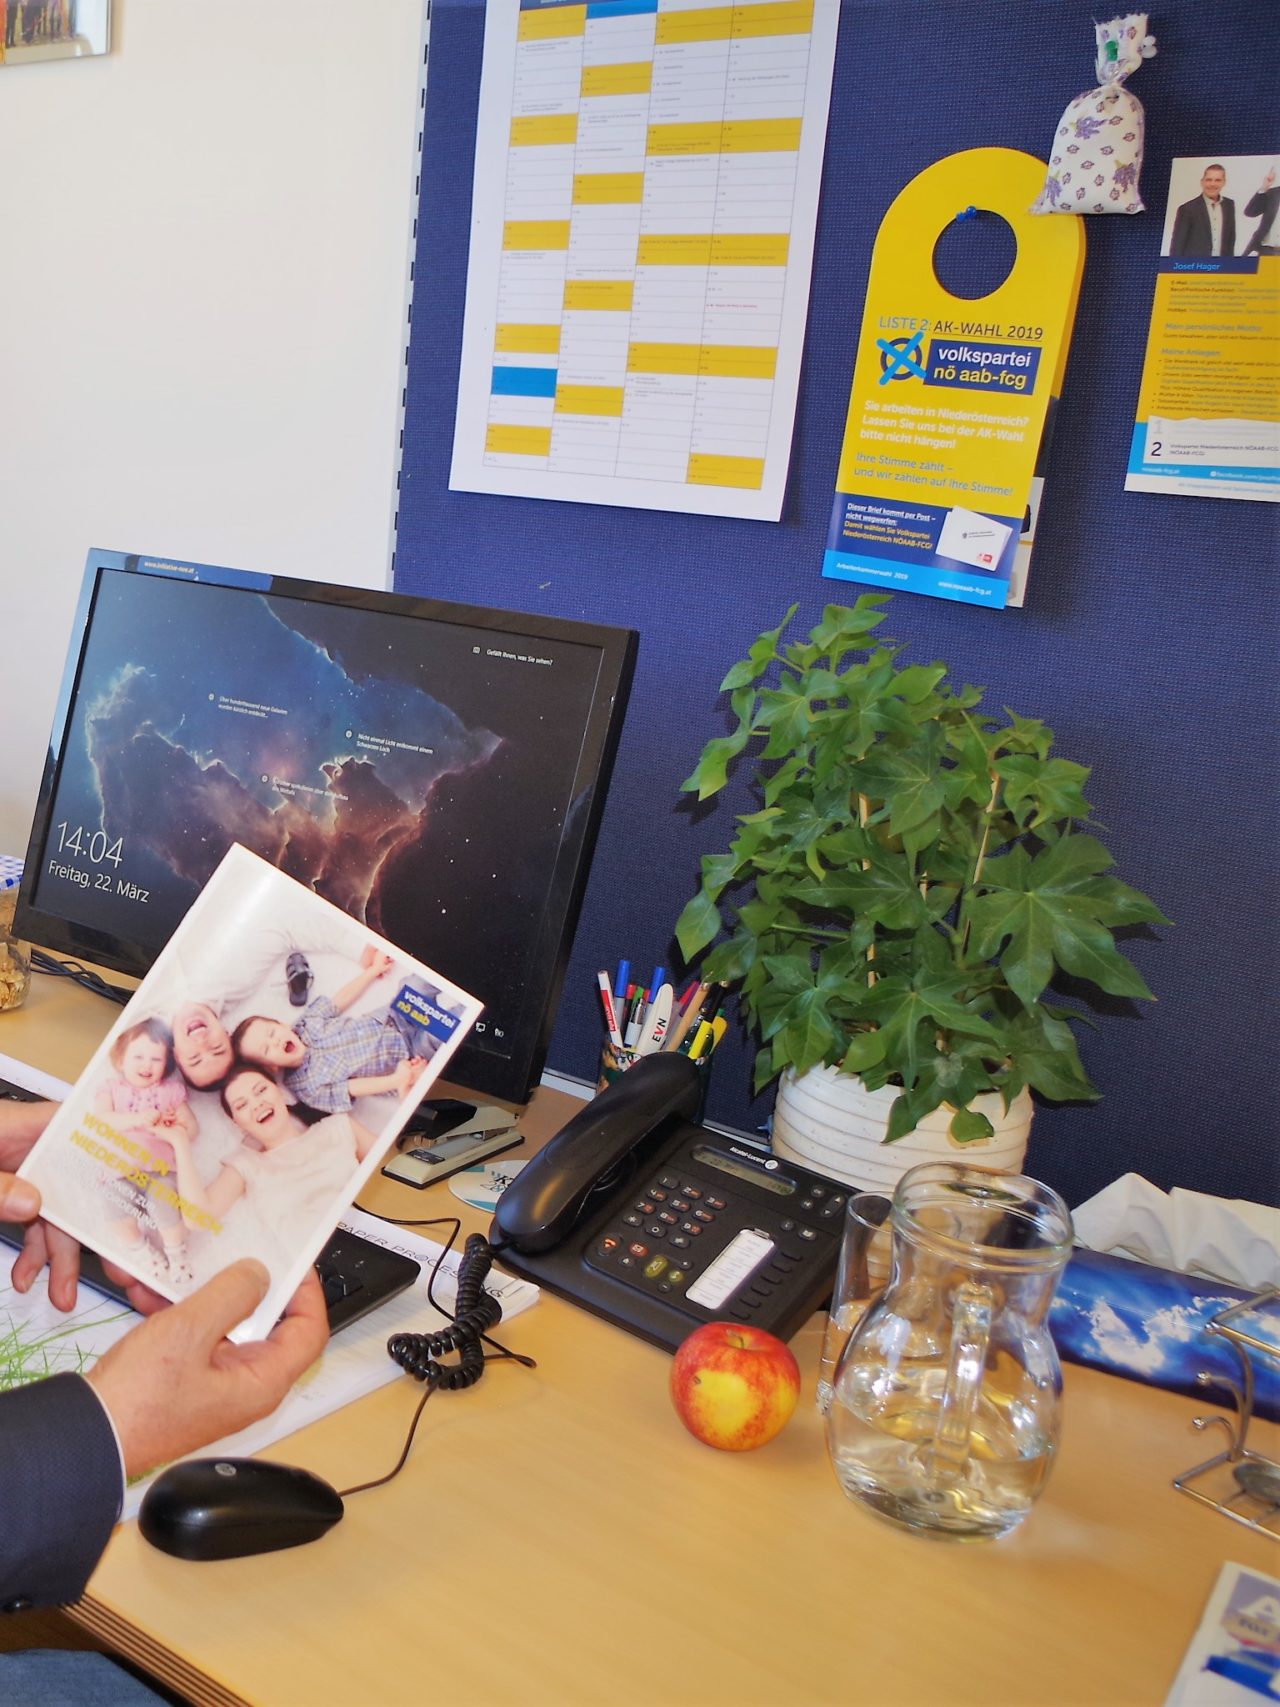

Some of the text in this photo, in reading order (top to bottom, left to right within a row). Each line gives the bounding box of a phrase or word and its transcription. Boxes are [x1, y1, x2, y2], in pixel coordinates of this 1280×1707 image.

[1173, 262, 1221, 271] Josef Hager
[879, 316, 917, 330] LISTE
[933, 320, 1003, 337] AK-WAHL
[1007, 325, 1043, 340] 2019
[938, 346, 1032, 367] volkspartei
[933, 365, 1027, 390] nö aab-fcg
[864, 400, 1030, 427] Sie arbeiten in Niederösterreich?
[860, 428, 958, 450] bitte nicht hängen!
[862, 415, 1025, 442] Lassen Sie uns bei der AK-Wahl
[856, 451, 876, 463] Ihre
[878, 454, 917, 469] Stimme
[919, 458, 944, 472] zählt
[1150, 441, 1162, 457] 2
[854, 467, 874, 478] und
[876, 469, 893, 479] wir
[929, 475, 948, 487] auf
[948, 478, 968, 490] Ihre
[970, 481, 1014, 496] Stimme!
[58, 821, 123, 869] 14:04
[48, 859, 150, 903] Freitag, 22. März
[396, 1000, 431, 1026] nö aab
[404, 990, 456, 1029] volkspartei
[651, 1017, 667, 1042] EVN
[82, 1111, 153, 1165] WOHNEN
[150, 1156, 170, 1177] IN
[729, 1146, 766, 1165] Alcatel-Lucent
[135, 1193, 157, 1212] ZUR
[337, 1221, 505, 1299] PAPER PROCESNG
